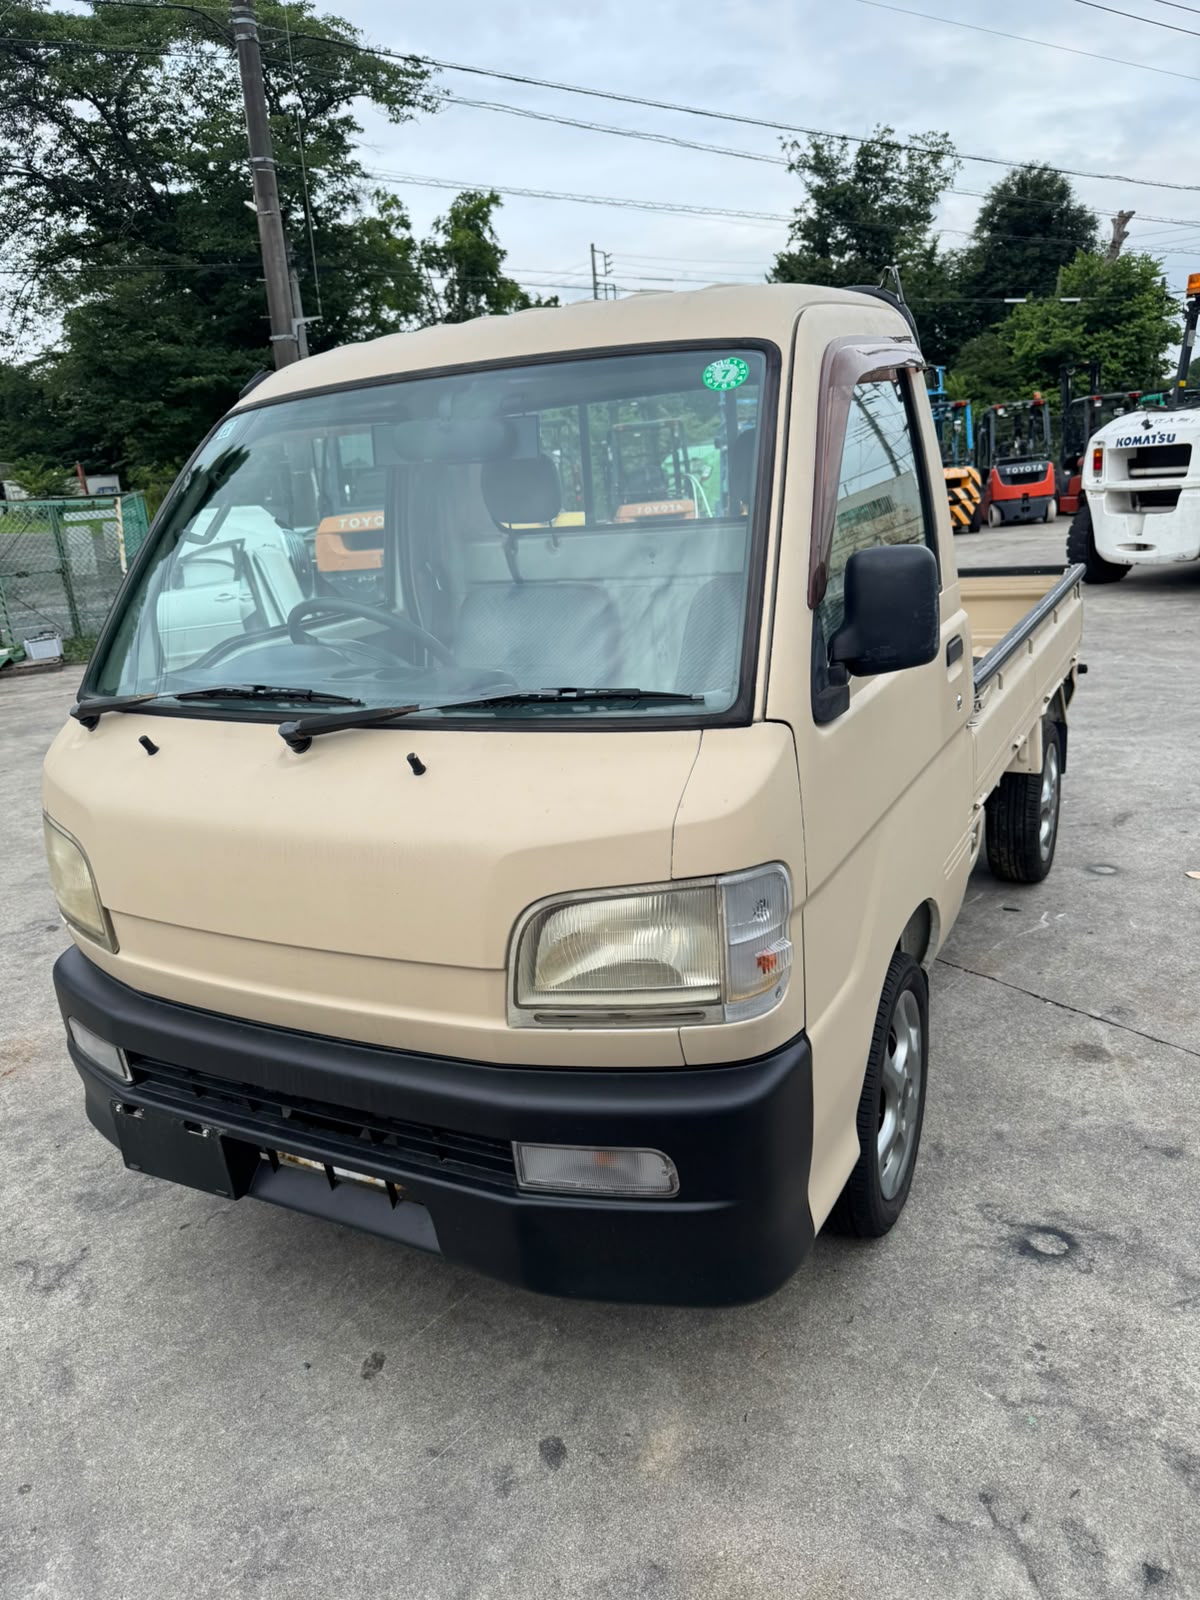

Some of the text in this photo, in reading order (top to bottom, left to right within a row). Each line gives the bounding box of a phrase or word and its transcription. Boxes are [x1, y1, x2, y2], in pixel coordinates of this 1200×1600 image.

[721, 369, 731, 380] 7
[1115, 431, 1177, 448] KOMATSU
[1006, 464, 1044, 475] TOYOTA
[637, 503, 684, 515] TOYOTA
